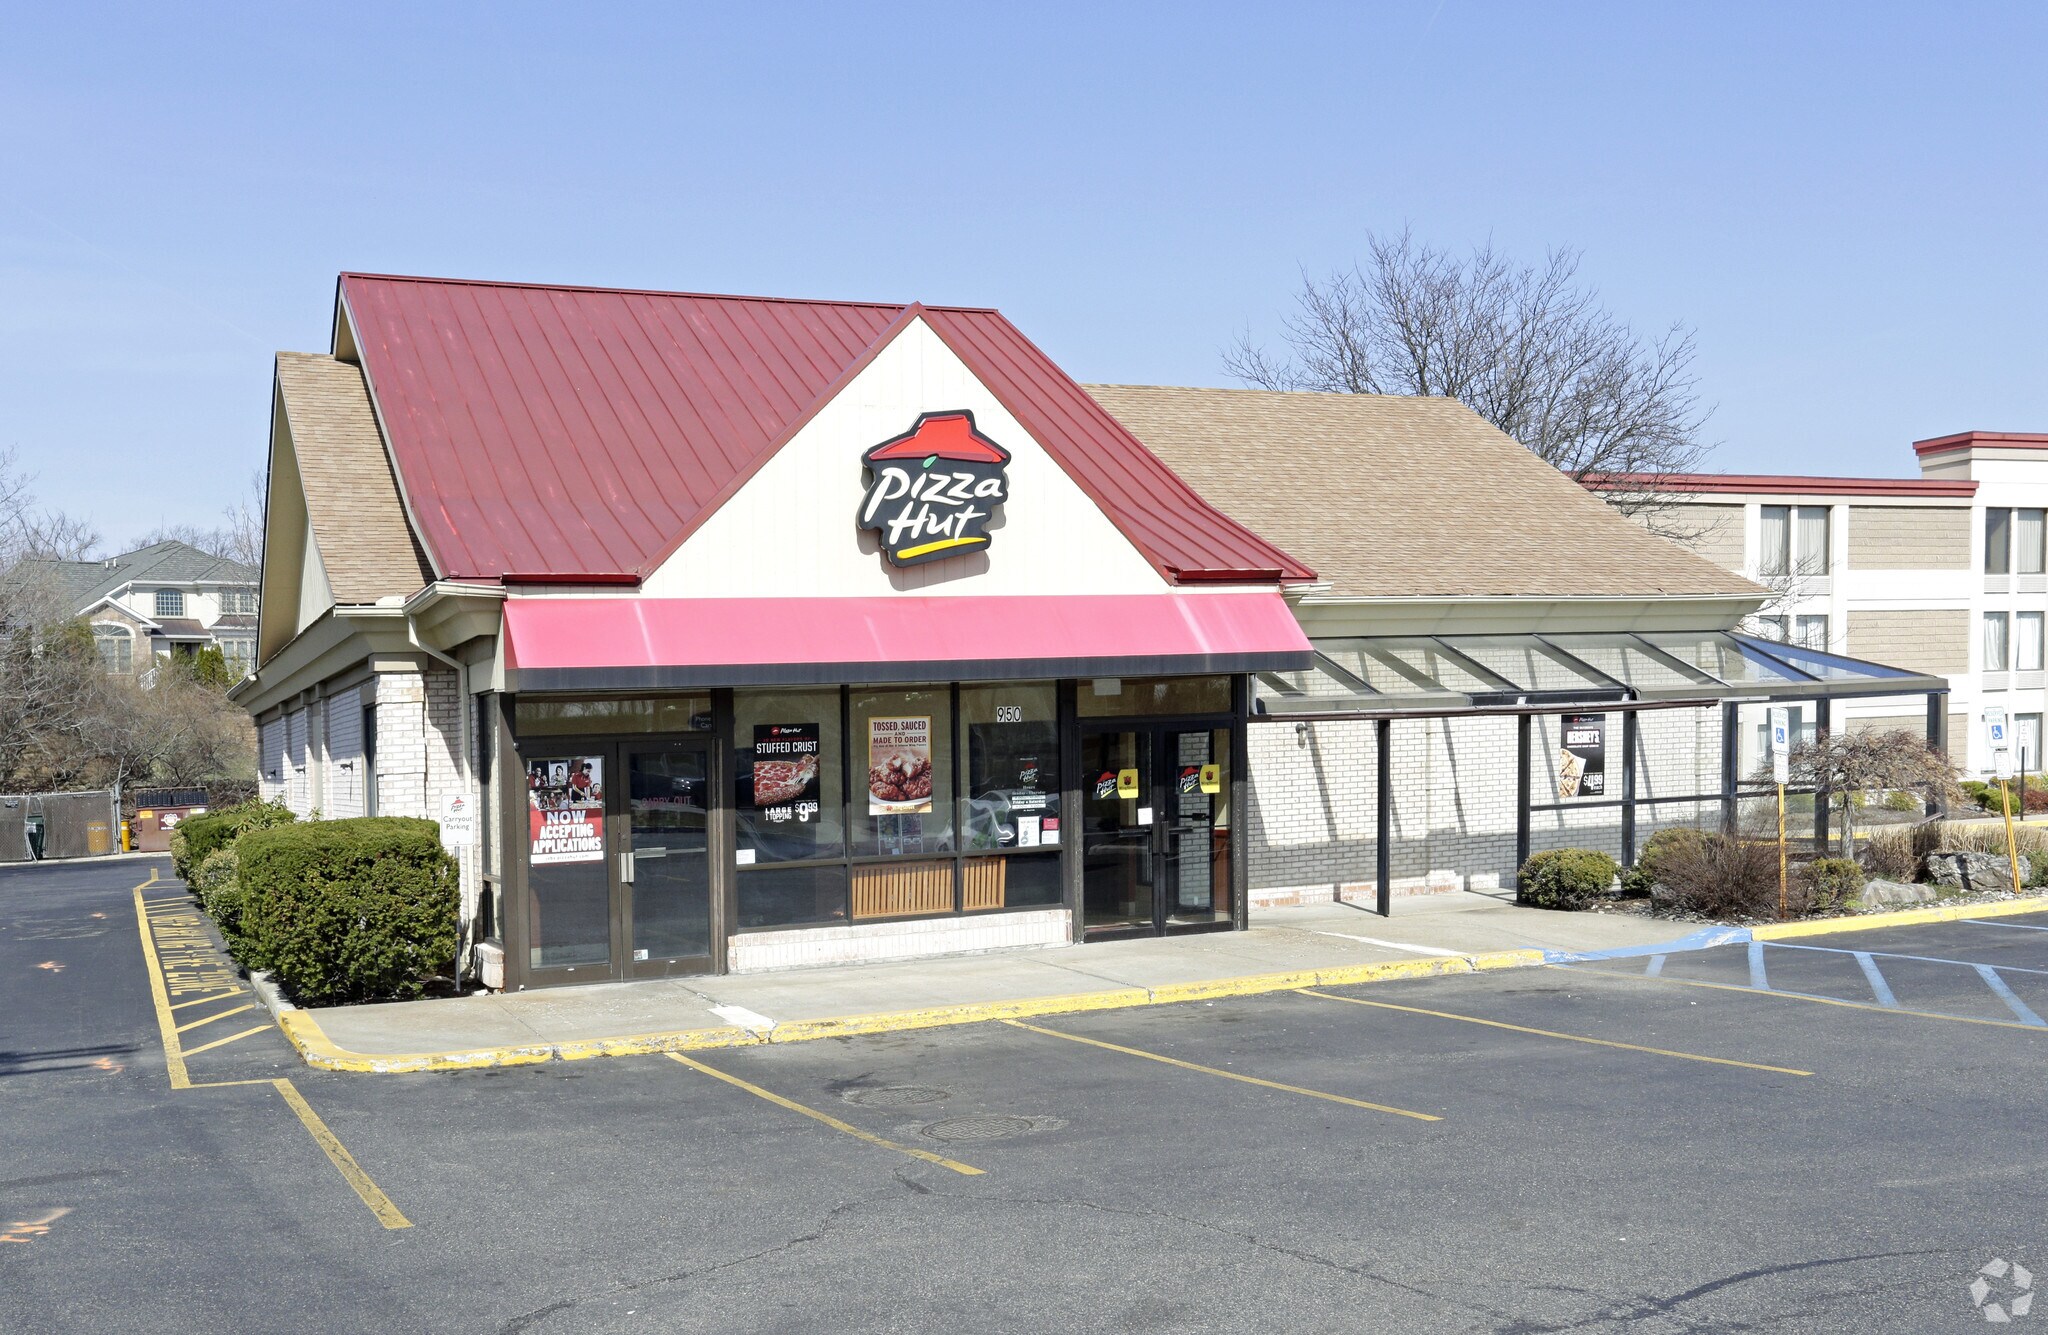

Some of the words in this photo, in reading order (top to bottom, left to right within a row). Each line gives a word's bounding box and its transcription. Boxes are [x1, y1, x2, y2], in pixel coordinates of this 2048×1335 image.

[864, 467, 1003, 522] Pizza
[888, 501, 986, 545] Hut
[997, 707, 1021, 722] 950
[873, 721, 900, 731] TOSSED,
[900, 720, 926, 731] SAUCED
[904, 735, 927, 743] ORDER
[756, 742, 790, 754] STUFFED
[792, 741, 817, 753] CRUST
[1097, 778, 1117, 794] Pizza
[1180, 774, 1199, 788] Pizza
[1183, 779, 1197, 789] Hut
[1100, 785, 1115, 796] Hut
[673, 796, 691, 806] OUT
[765, 806, 792, 814] LARGE
[770, 812, 792, 820] TOPPING
[443, 815, 473, 823] Carryout
[546, 810, 587, 825] NOW
[446, 823, 470, 831] Parking
[540, 823, 594, 840] ACCEPTING
[532, 836, 602, 854] APPLICATIONS
[160, 949, 226, 970] FIRE
[165, 969, 241, 996] ZONE
